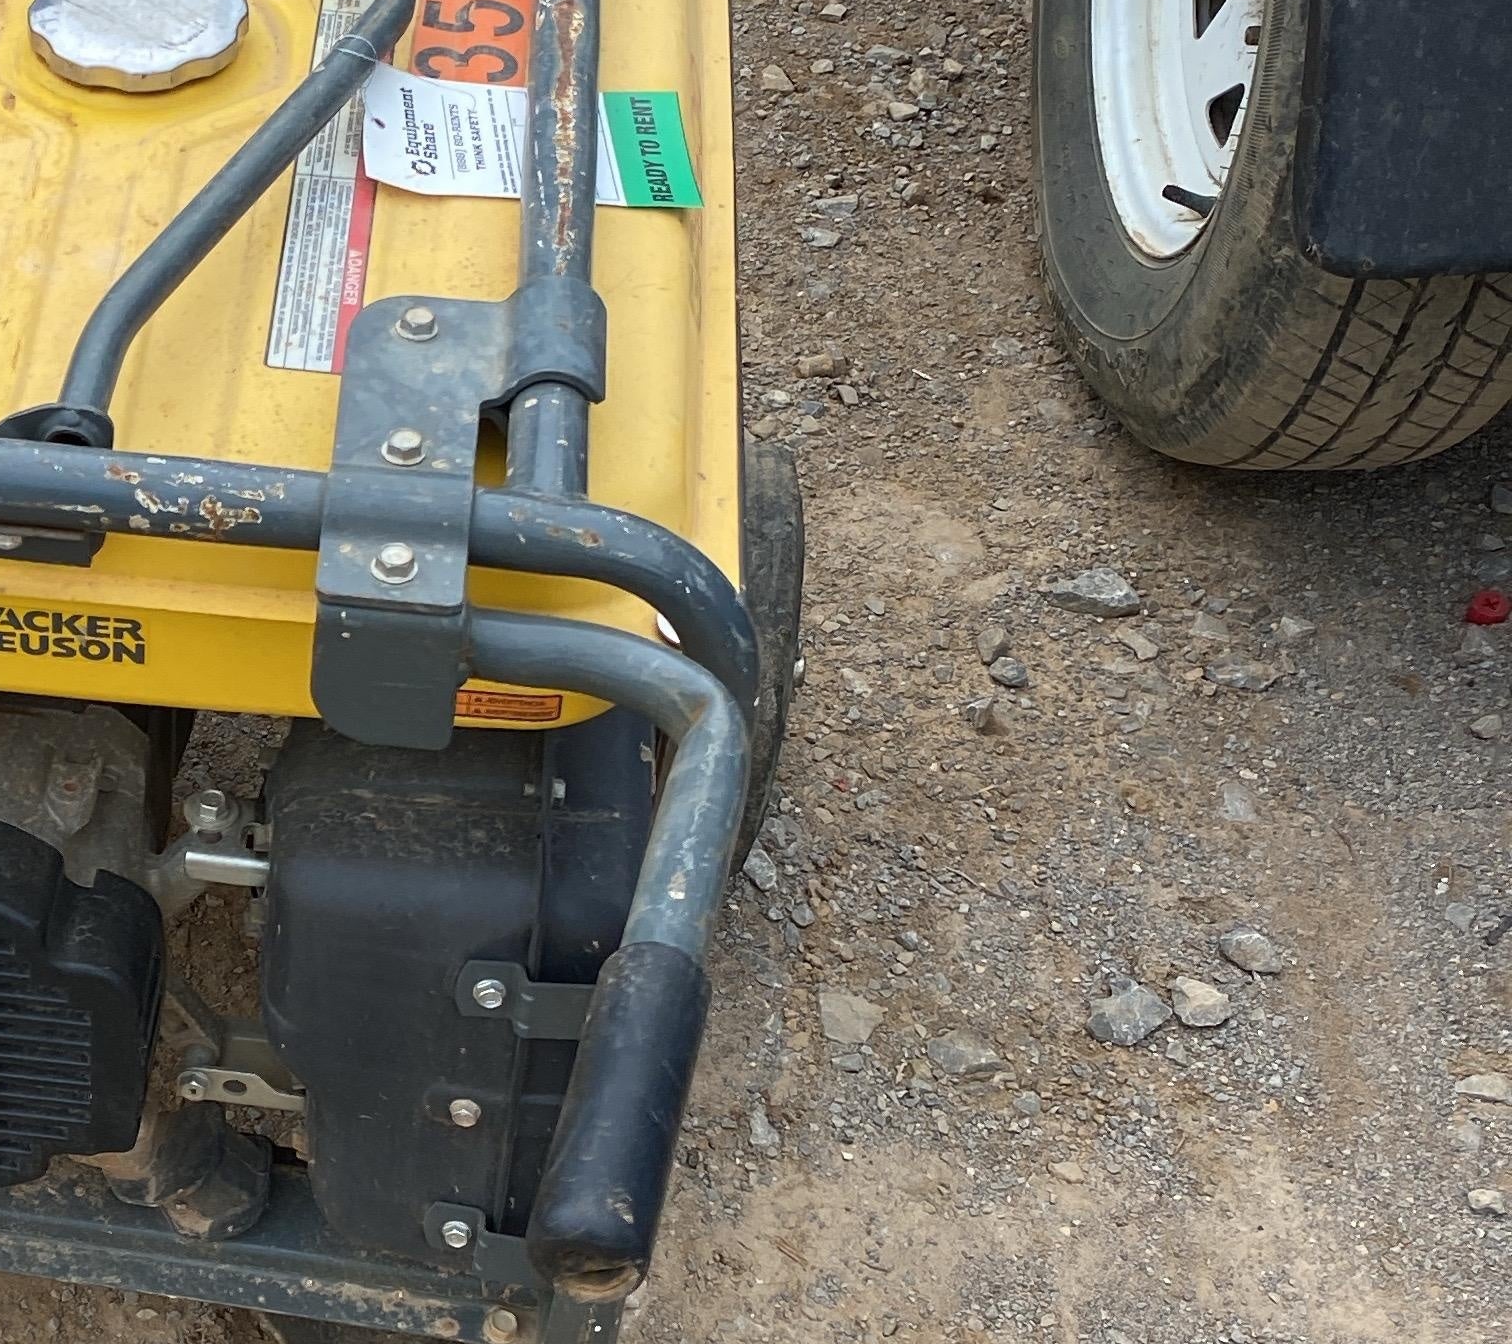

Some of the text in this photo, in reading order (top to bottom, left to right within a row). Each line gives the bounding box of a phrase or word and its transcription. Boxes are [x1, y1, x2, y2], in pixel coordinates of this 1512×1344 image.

[400, 87, 423, 157] Equipment
[423, 123, 438, 160] Share
[467, 109, 486, 170] THINK SAFETY
[629, 96, 675, 203] READY TO RENT
